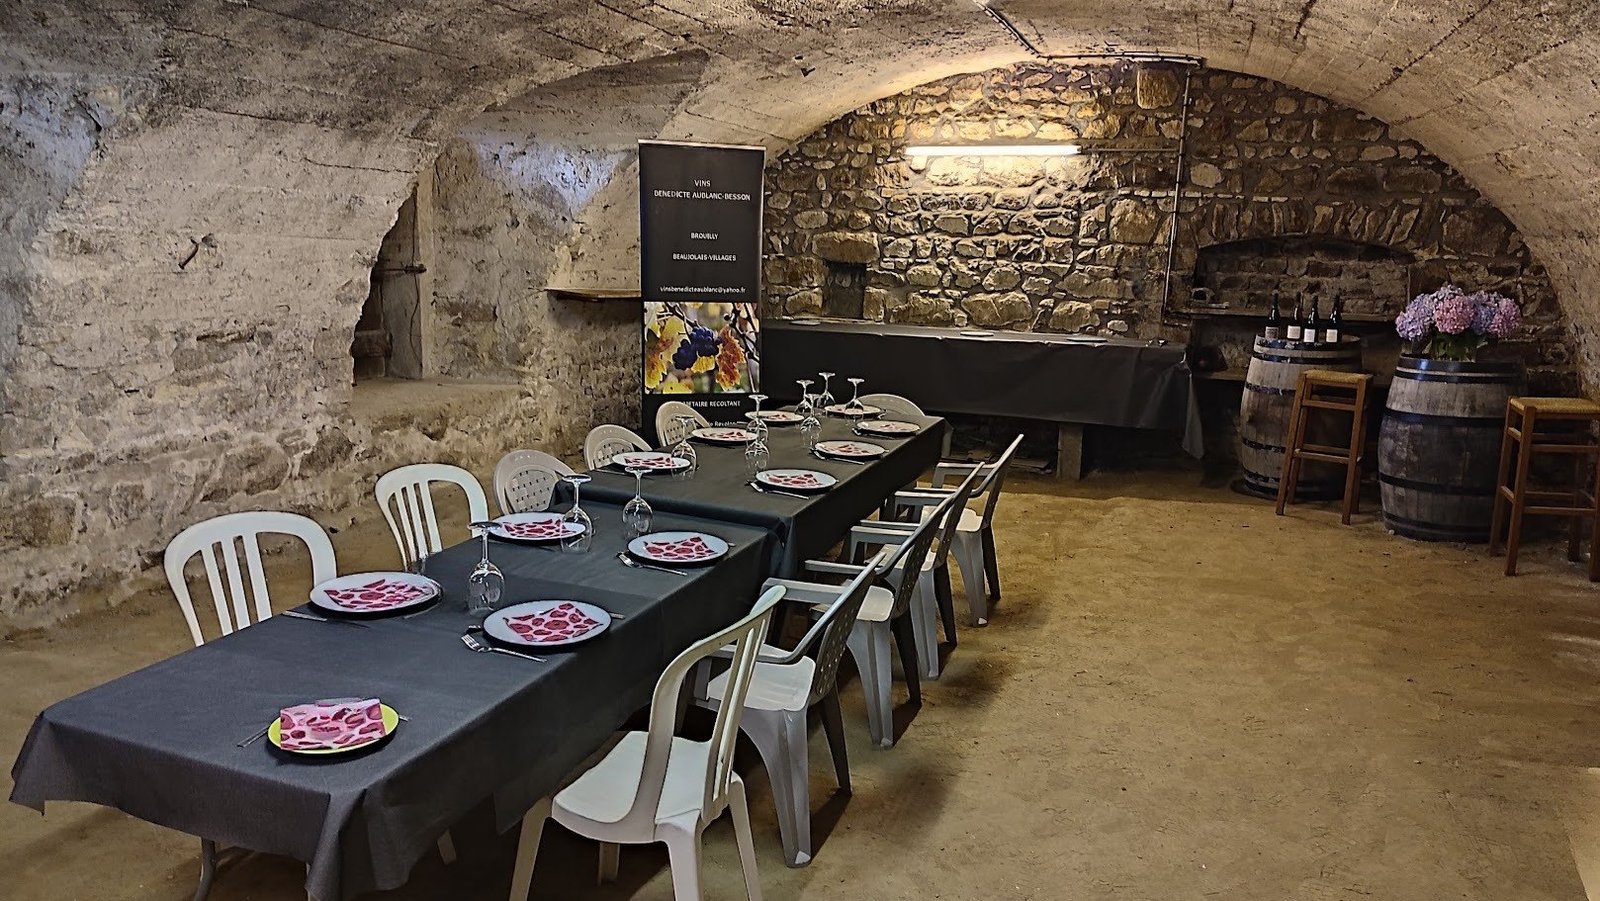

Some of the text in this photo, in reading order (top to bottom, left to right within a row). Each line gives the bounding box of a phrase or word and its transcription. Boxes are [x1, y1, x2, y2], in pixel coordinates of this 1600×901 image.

[654, 190, 751, 201] BENEDICTE AUBLANC-BESSON
[690, 232, 719, 240] BROUILLY
[672, 253, 737, 262] BEAUJOLAIS-VILLAGES
